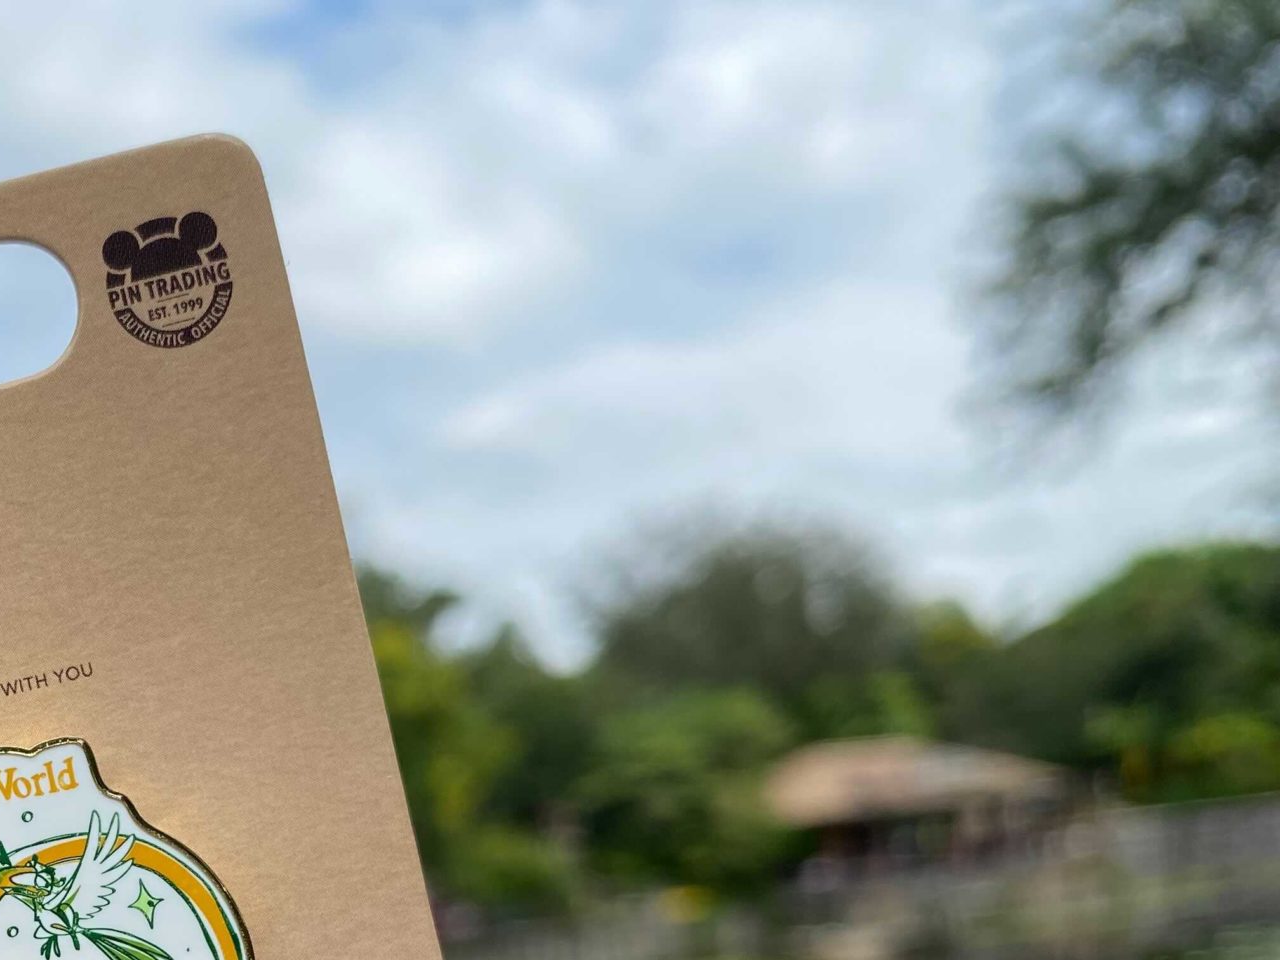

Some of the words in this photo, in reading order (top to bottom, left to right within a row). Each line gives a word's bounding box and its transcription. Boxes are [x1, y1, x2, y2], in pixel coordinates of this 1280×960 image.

[107, 285, 142, 310] PIN
[144, 262, 231, 299] TRADING
[119, 310, 186, 346] AUTHENTIC
[190, 288, 231, 339] OFFICIAL
[147, 307, 171, 322] EST.
[173, 297, 204, 315] 1999
[0, 672, 49, 697] WITH
[53, 662, 95, 684] YOU
